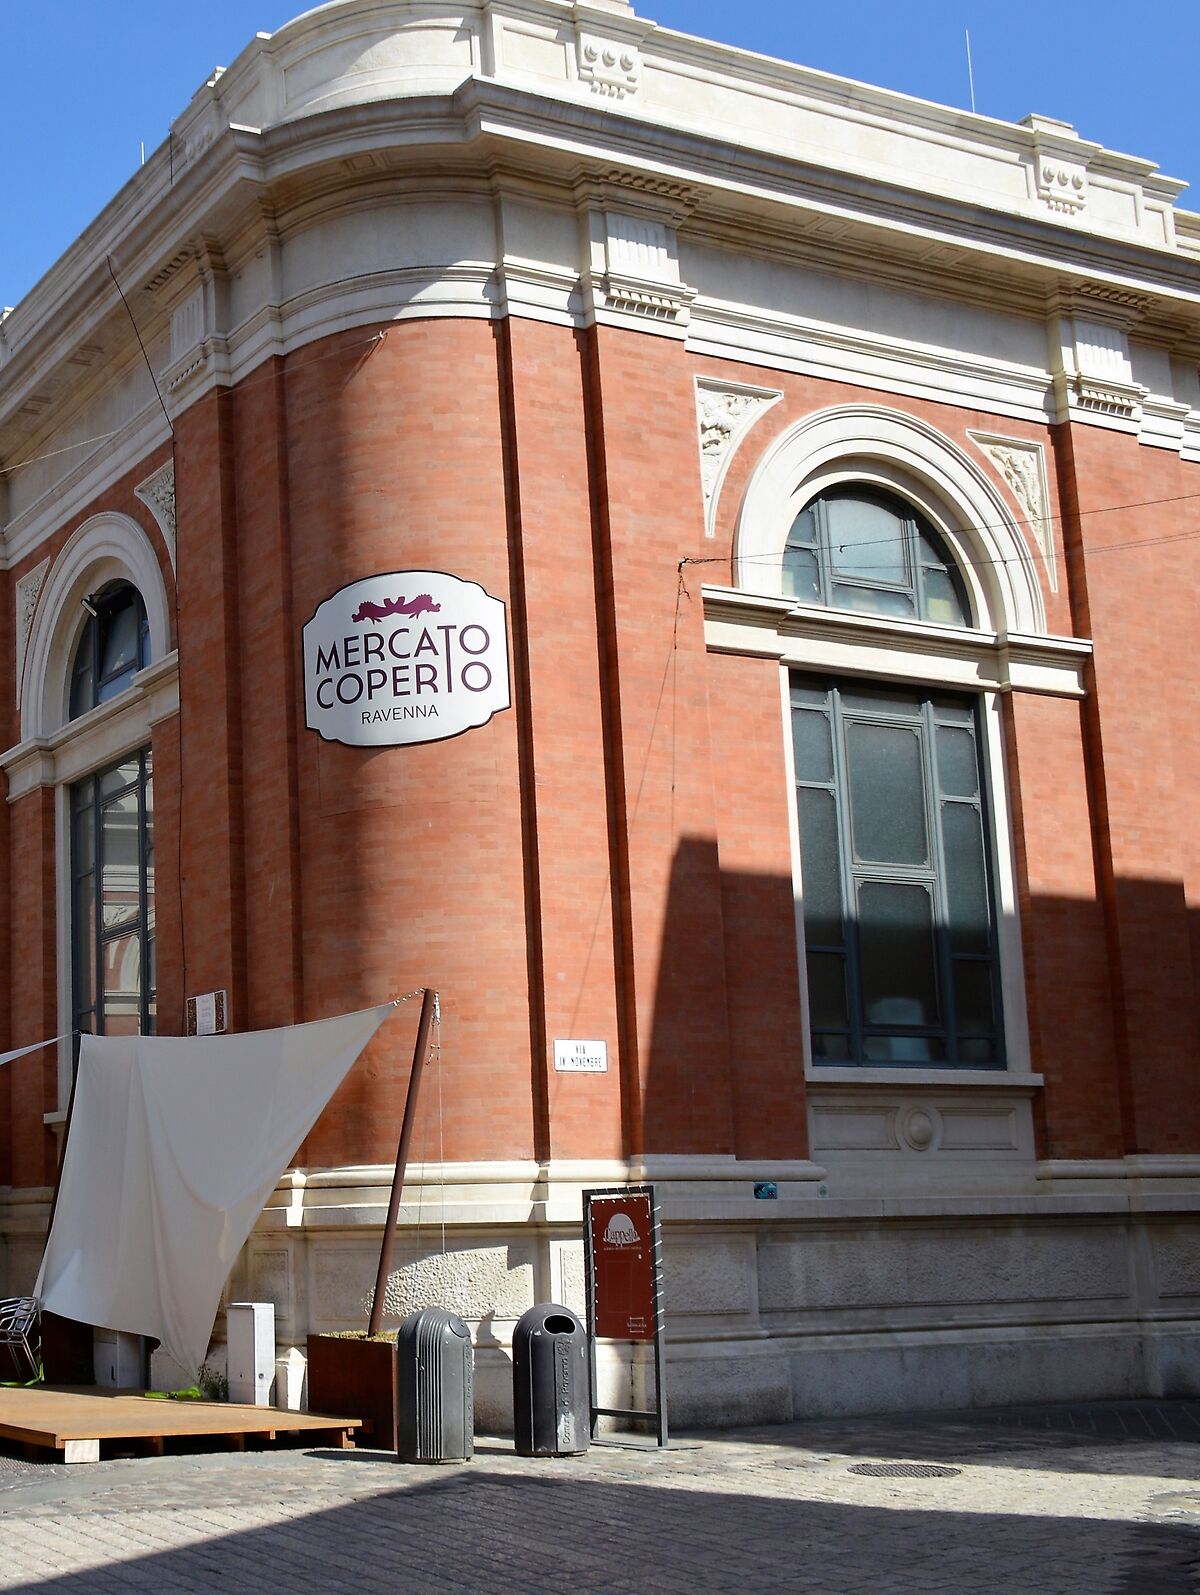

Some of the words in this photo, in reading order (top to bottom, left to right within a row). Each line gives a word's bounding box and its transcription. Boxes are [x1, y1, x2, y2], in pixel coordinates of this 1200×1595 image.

[315, 624, 490, 675] MERCATO
[316, 661, 492, 709] COPERTO
[361, 704, 439, 725] RAVENNA
[603, 1227, 638, 1248] Cappello
